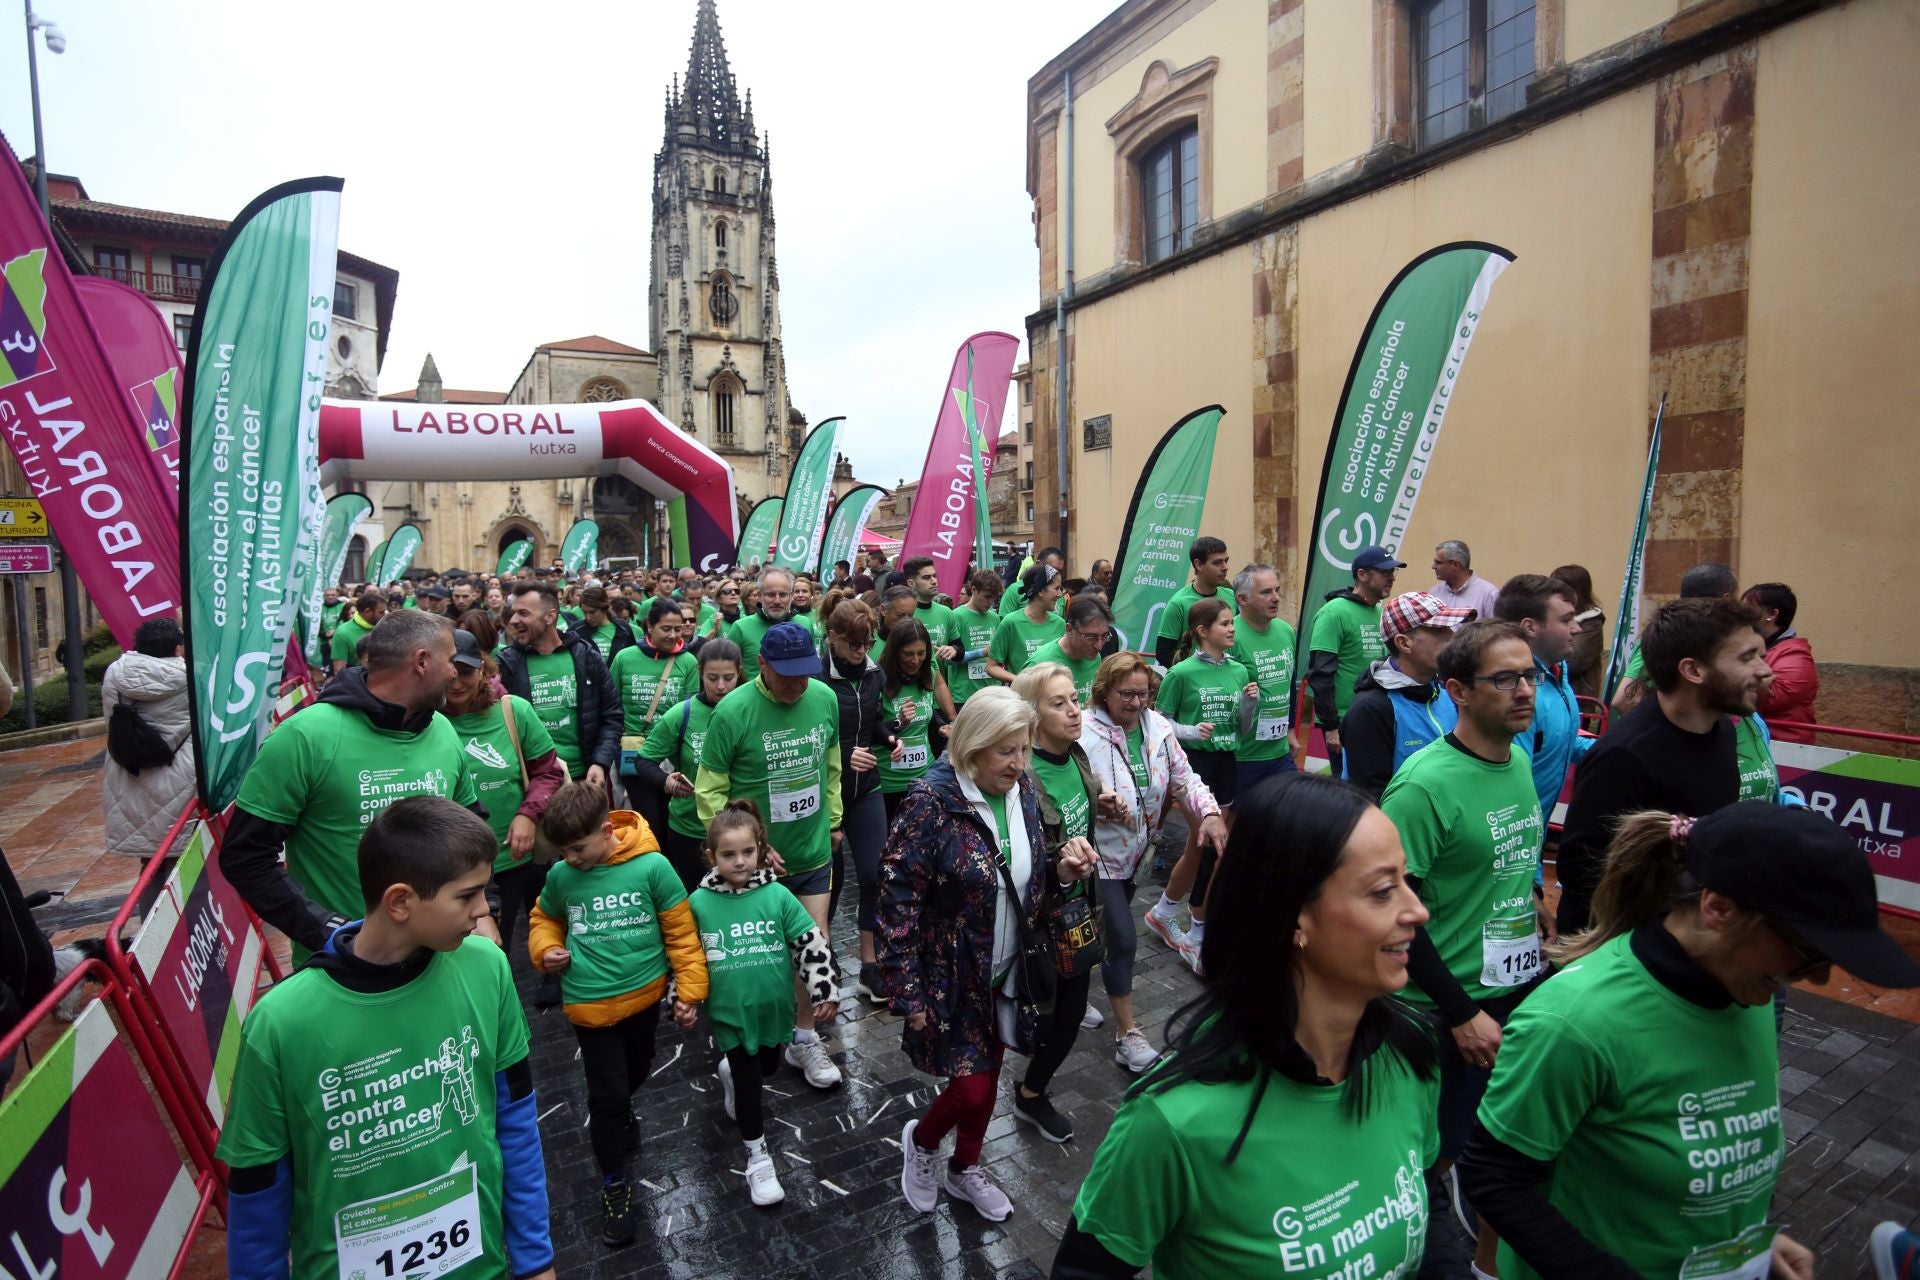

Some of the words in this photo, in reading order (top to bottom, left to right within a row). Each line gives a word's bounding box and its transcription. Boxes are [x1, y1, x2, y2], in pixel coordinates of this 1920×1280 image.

[1342, 395, 1376, 493] asociación
[1370, 319, 1405, 398] española
[392, 409, 575, 436] LABORAL
[1361, 443, 1382, 498] contra
[1376, 422, 1388, 442] el
[1382, 360, 1410, 422] cáncer
[1385, 310, 1478, 556] ontraelcancer.es
[236, 404, 260, 507] cáncer
[530, 440, 577, 456] kutxa
[647, 437, 666, 454] banca
[665, 451, 698, 475] cooperativa
[1374, 481, 1384, 503] en
[1379, 410, 1414, 480] Asturias
[789, 491, 801, 529] asociación
[237, 511, 257, 537] el
[256, 480, 282, 593] Asturias
[1158, 539, 1184, 552] gran
[208, 481, 229, 627] asociación
[1142, 551, 1180, 563] camino
[1137, 563, 1156, 574] por
[1134, 574, 1177, 590] delante
[262, 600, 282, 631] en
[1256, 658, 1264, 666] En
[1257, 664, 1276, 672] contra
[531, 689, 549, 697] ntra
[1201, 695, 1212, 703] En
[1202, 703, 1225, 711] contra
[1202, 711, 1210, 719] el
[764, 742, 778, 752] En
[781, 734, 817, 749] marcha
[766, 748, 800, 762] contra
[768, 762, 777, 771] el
[780, 755, 813, 769] cáncer
[902, 752, 926, 763] 1303
[359, 783, 380, 797] En
[384, 778, 433, 793] marcha
[789, 796, 815, 814] 820
[1490, 826, 1507, 841] En
[1494, 834, 1523, 856] contra
[1492, 857, 1505, 870] el
[592, 891, 642, 912] aecc
[593, 921, 608, 931] en
[610, 909, 652, 929] marcha
[596, 908, 628, 920] ASTURIAS
[597, 932, 621, 943] Contra
[730, 919, 776, 938] aecc
[731, 946, 746, 958] en
[748, 941, 785, 954] marcha
[734, 937, 762, 946] ASTURIAS
[174, 906, 219, 1012] LABORAL
[710, 963, 734, 974] Carrera
[734, 960, 758, 970] Contra
[758, 958, 766, 966] el
[766, 956, 785, 966] Cáncer
[1503, 950, 1538, 974] 1126
[344, 1056, 376, 1070] asociación
[376, 1048, 402, 1060] española
[344, 1067, 364, 1076] contra
[371, 1058, 391, 1068] cáncer
[320, 1088, 356, 1112] En
[364, 1052, 452, 1099] marcha
[354, 1068, 378, 1080] Asturias
[326, 1094, 406, 1131] contra
[1678, 1116, 1717, 1141] En
[1724, 1104, 1780, 1136] marc
[328, 1130, 350, 1152] el
[358, 1101, 441, 1146] cáncer
[1688, 1137, 1762, 1170] contra
[1689, 1171, 1713, 1194] el
[342, 1206, 377, 1220] Oviedo
[378, 1204, 390, 1212] en
[392, 1192, 427, 1208] marcha
[428, 1180, 456, 1195] contra
[1302, 1193, 1335, 1212] asociación
[1334, 1180, 1360, 1198] española
[1304, 1208, 1326, 1222] contra
[1326, 1203, 1332, 1212] el
[1332, 1194, 1351, 1210] cáncer
[354, 1214, 388, 1228] cáncer
[406, 1216, 437, 1233] CORRES?
[1308, 1223, 1317, 1232] en
[1317, 1211, 1342, 1228] Asturias
[1279, 1240, 1326, 1272] En
[1332, 1194, 1416, 1258] marcha
[375, 1218, 470, 1278] 1236
